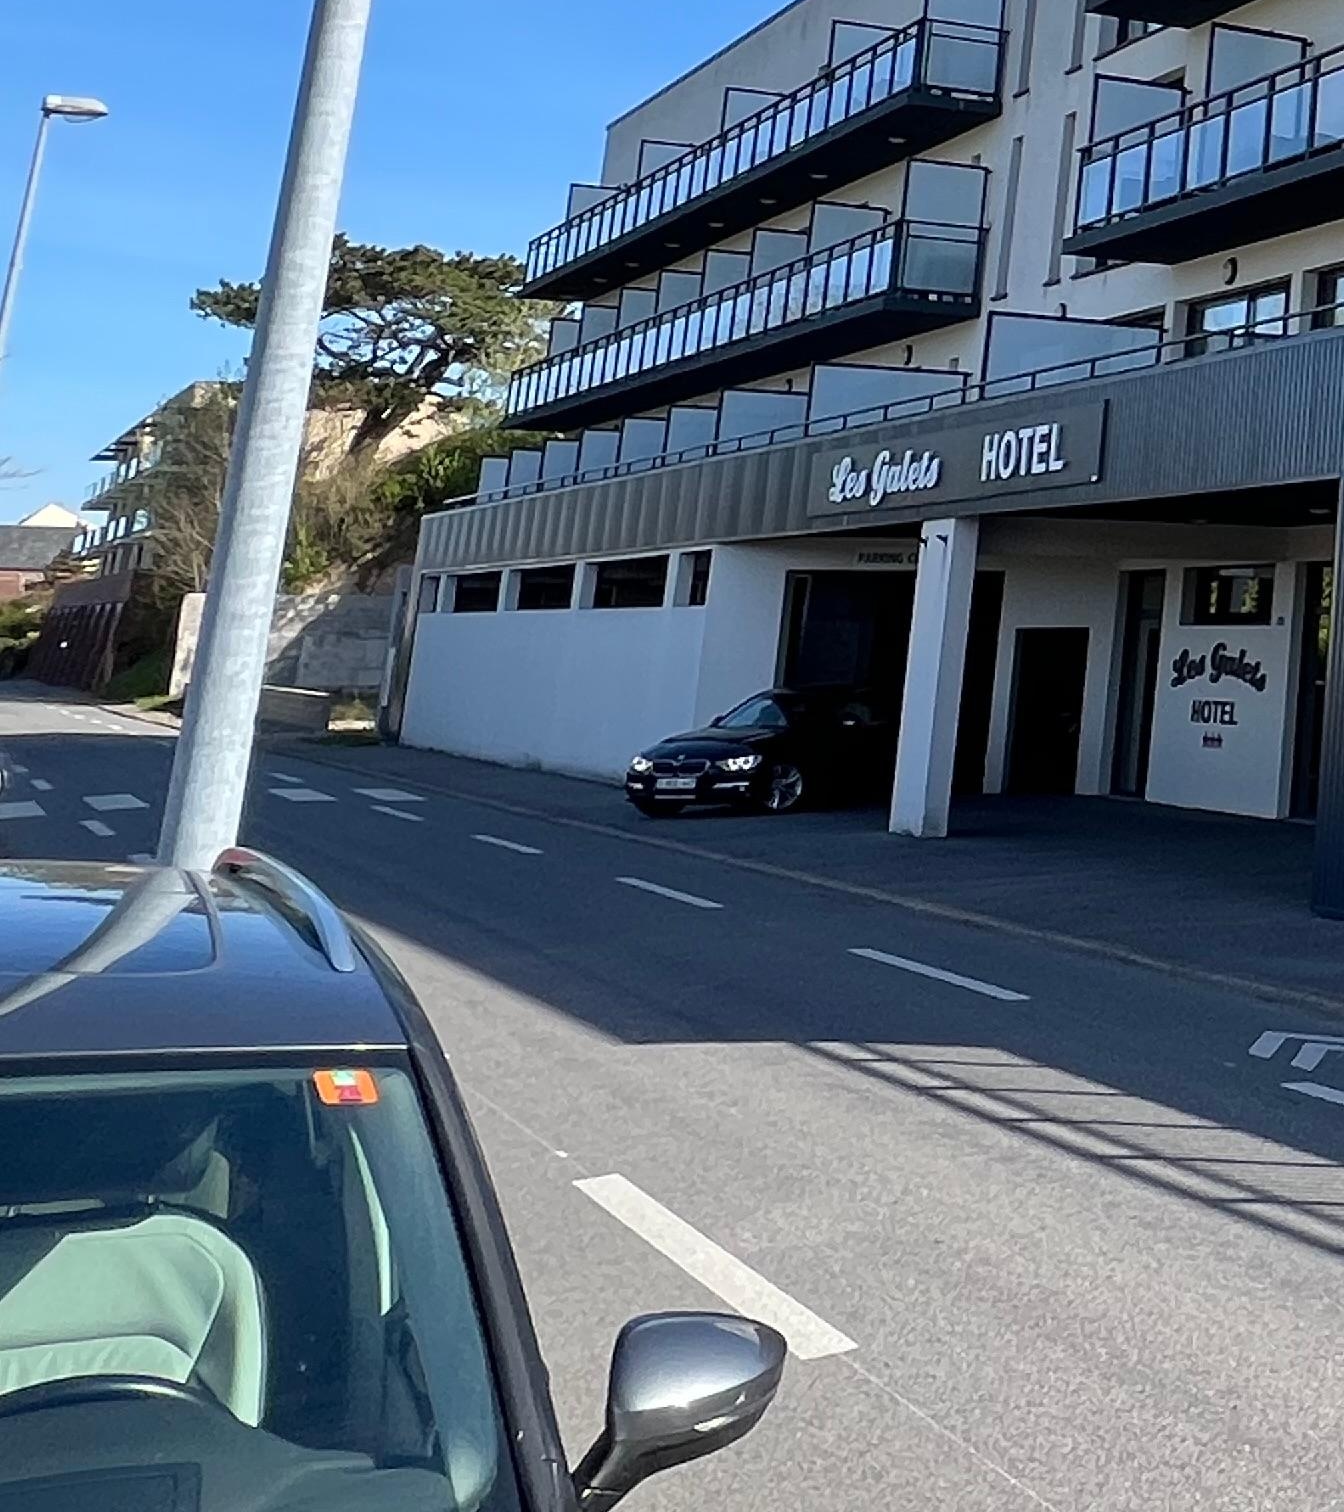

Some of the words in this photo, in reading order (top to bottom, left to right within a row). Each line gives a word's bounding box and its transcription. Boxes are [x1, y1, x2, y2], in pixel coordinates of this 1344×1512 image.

[828, 455, 869, 504] Les
[868, 448, 941, 507] Galets
[980, 422, 1067, 482] HOTEL
[1170, 648, 1206, 688] Les
[1208, 642, 1267, 692] Galets
[1190, 700, 1239, 725] HOTEL
